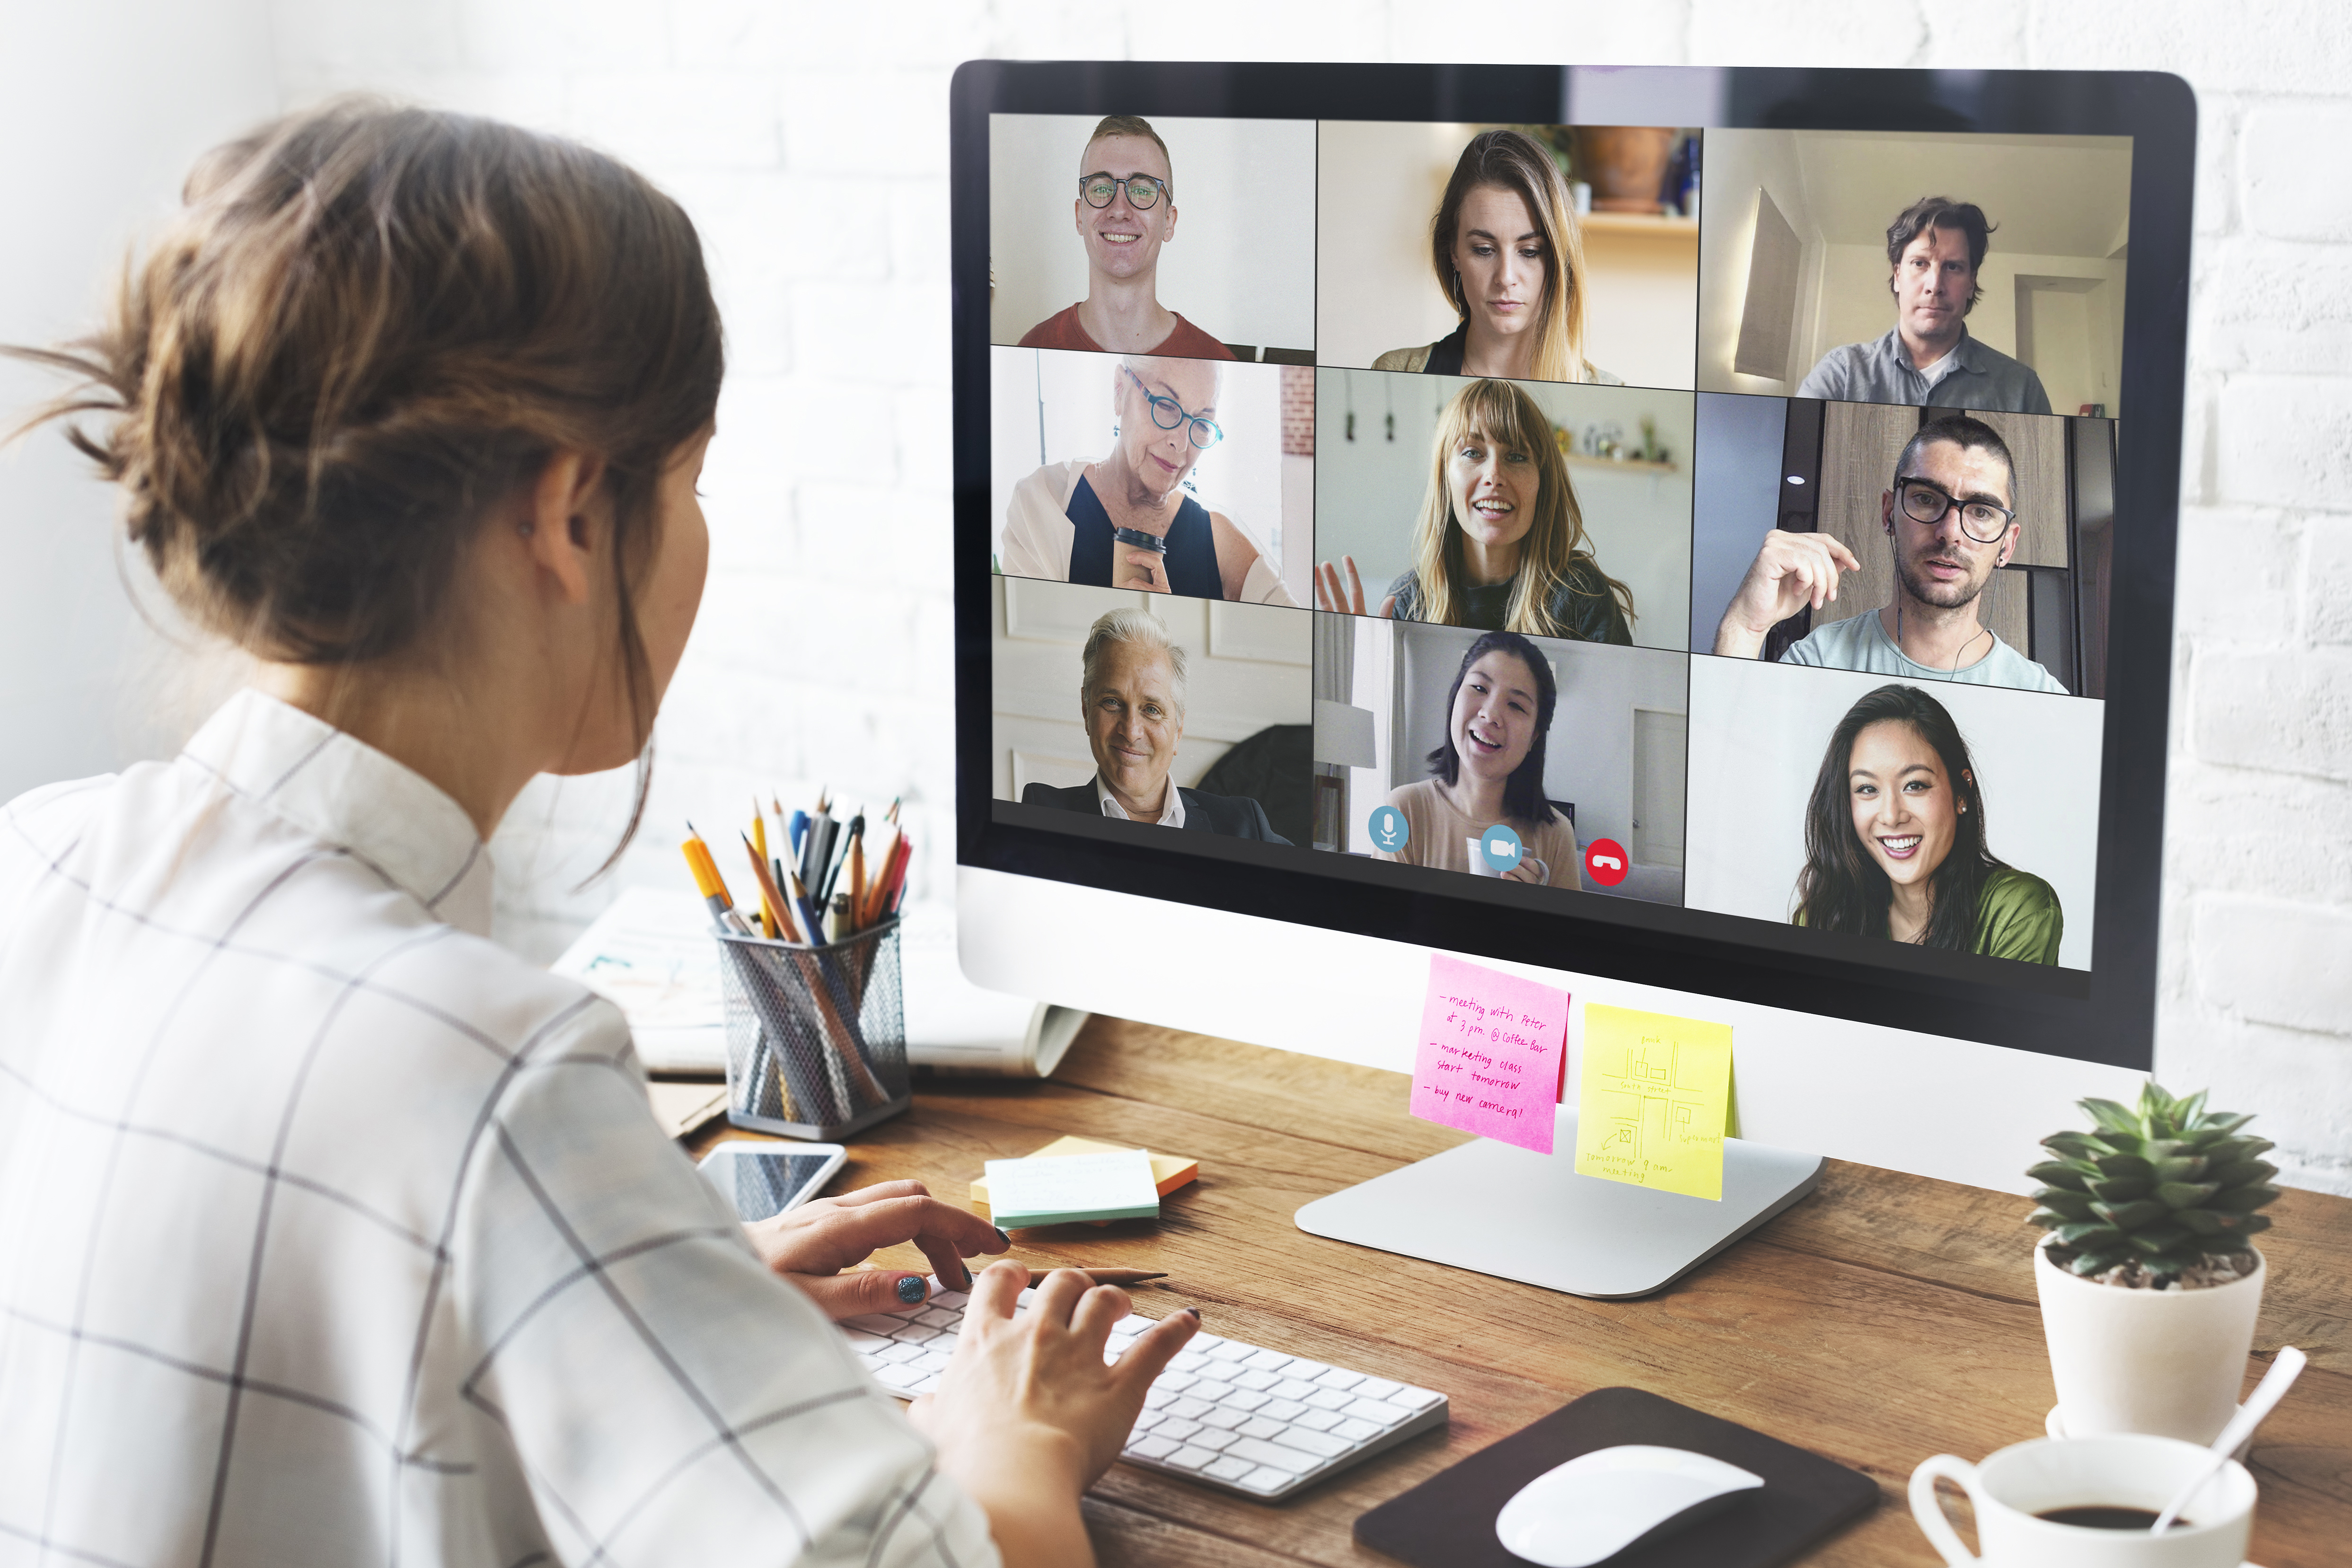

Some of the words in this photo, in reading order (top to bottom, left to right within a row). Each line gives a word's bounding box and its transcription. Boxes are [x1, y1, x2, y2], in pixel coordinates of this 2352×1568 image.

[1449, 997, 1485, 1021] meeting
[1490, 1006, 1513, 1022] with
[1521, 1015, 1546, 1030] Peter
[1447, 1011, 1457, 1022] at
[1461, 1020, 1466, 1031] 3
[1491, 1028, 1500, 1041] @
[1530, 1039, 1548, 1053] Bar
[1441, 1044, 1492, 1069] marketing
[1500, 1061, 1522, 1074] class
[1471, 1071, 1520, 1089] tomorrow
[1435, 1085, 1449, 1102] buy
[1456, 1092, 1473, 1103] new
[1479, 1100, 1523, 1119] camera!
[1586, 1153, 1635, 1165] Tomorrow
[1603, 1166, 1645, 1183] meeting
